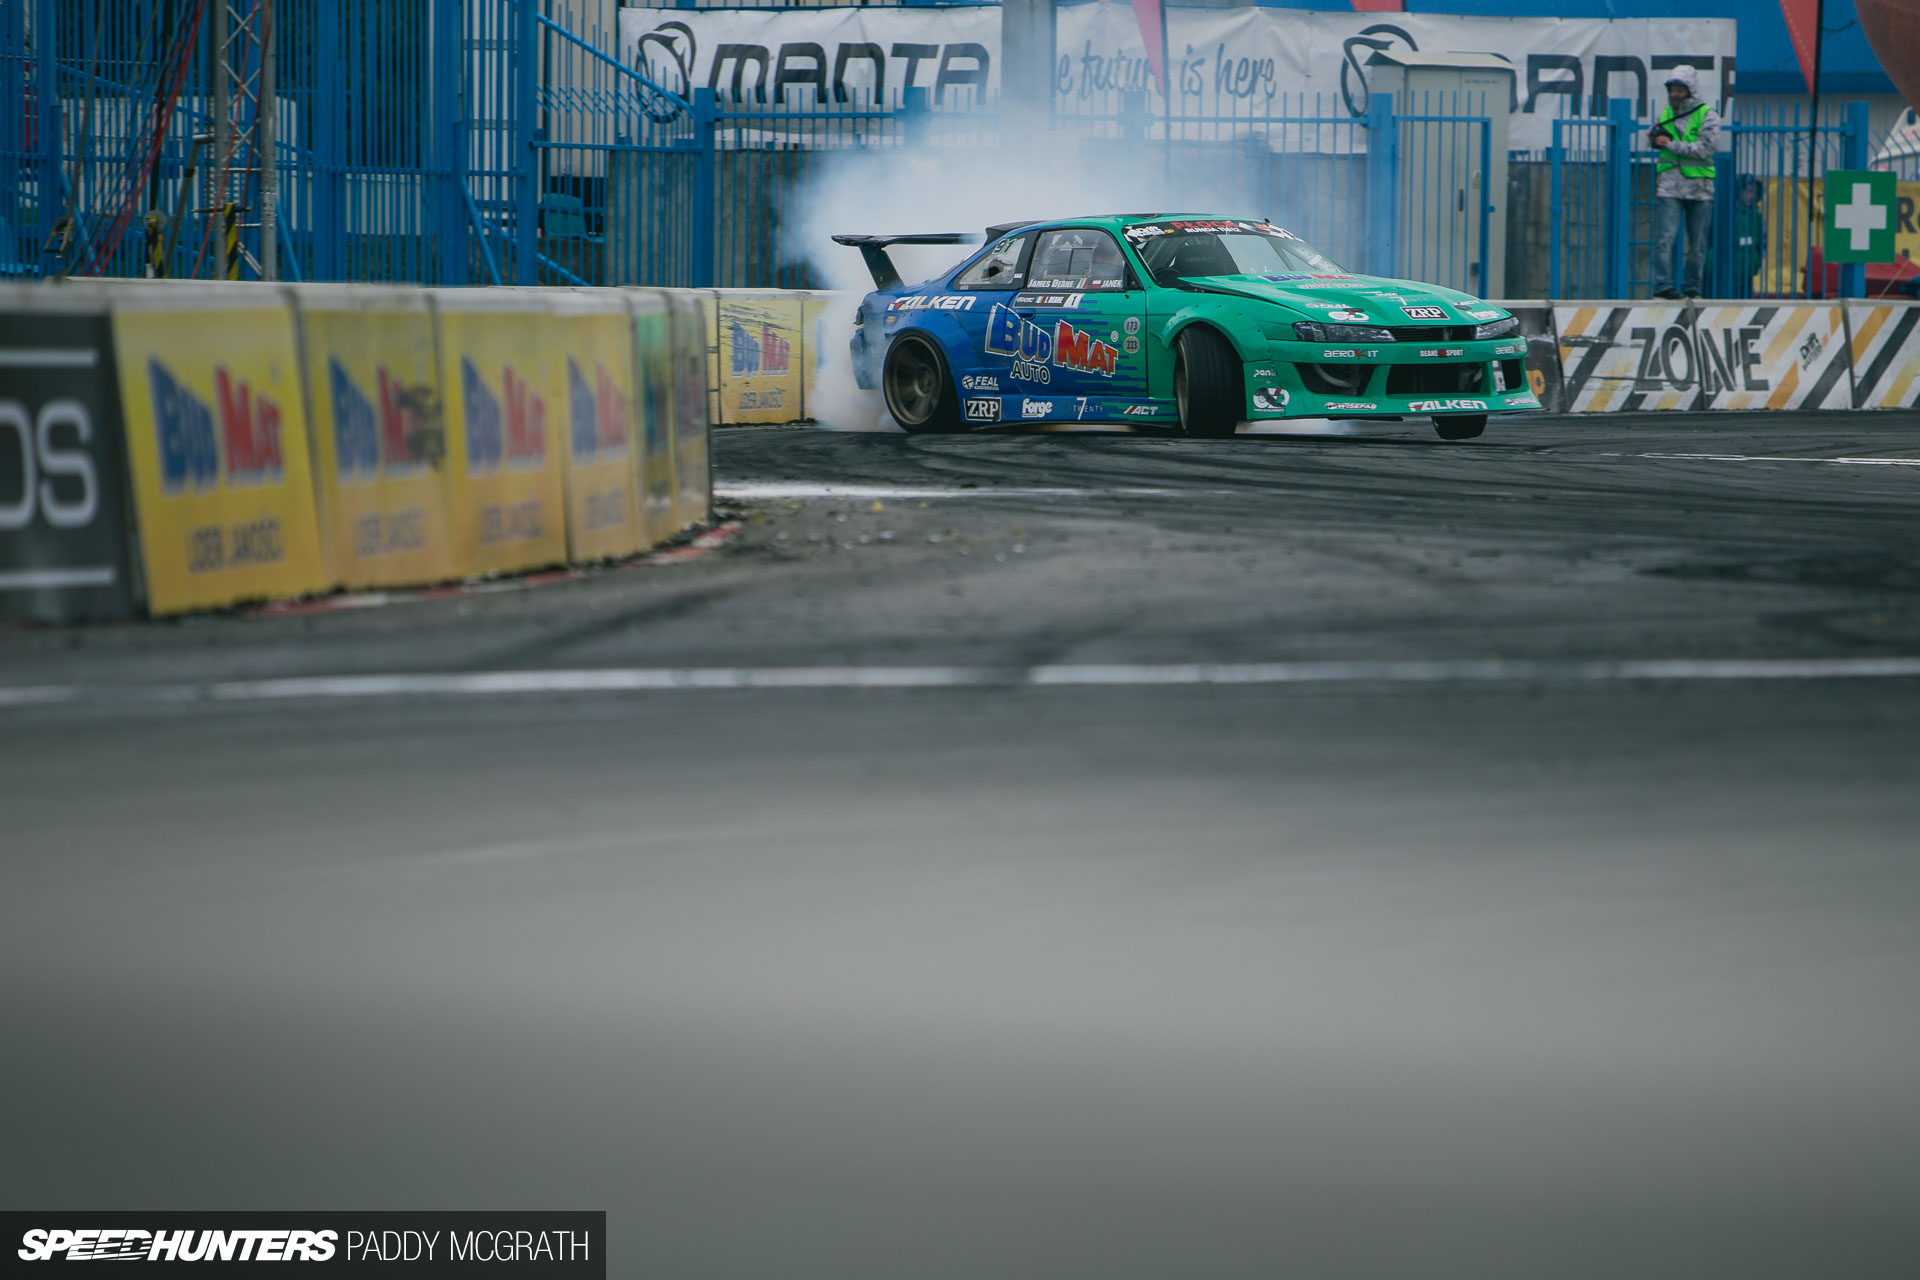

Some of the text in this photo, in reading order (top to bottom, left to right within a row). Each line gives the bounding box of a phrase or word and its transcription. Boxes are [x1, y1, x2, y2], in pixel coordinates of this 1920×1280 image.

[708, 42, 991, 105] MANTA
[1179, 43, 1205, 96] is
[1215, 42, 1277, 99] here
[1027, 279, 1075, 288] JAMES DEANE
[1101, 279, 1122, 288] JANEK
[887, 295, 977, 311] FALKEN
[1406, 308, 1442, 318] ZRP
[1125, 320, 1138, 331] 173
[985, 302, 1119, 378] BUD MAT
[1125, 340, 1138, 350] 223
[1631, 325, 1770, 393] ZONE
[1010, 360, 1050, 385] AUTO
[975, 376, 999, 387] FEAL
[966, 400, 999, 418] ZRP
[1022, 398, 1053, 417] Forge
[1409, 400, 1488, 411] FALKEN
